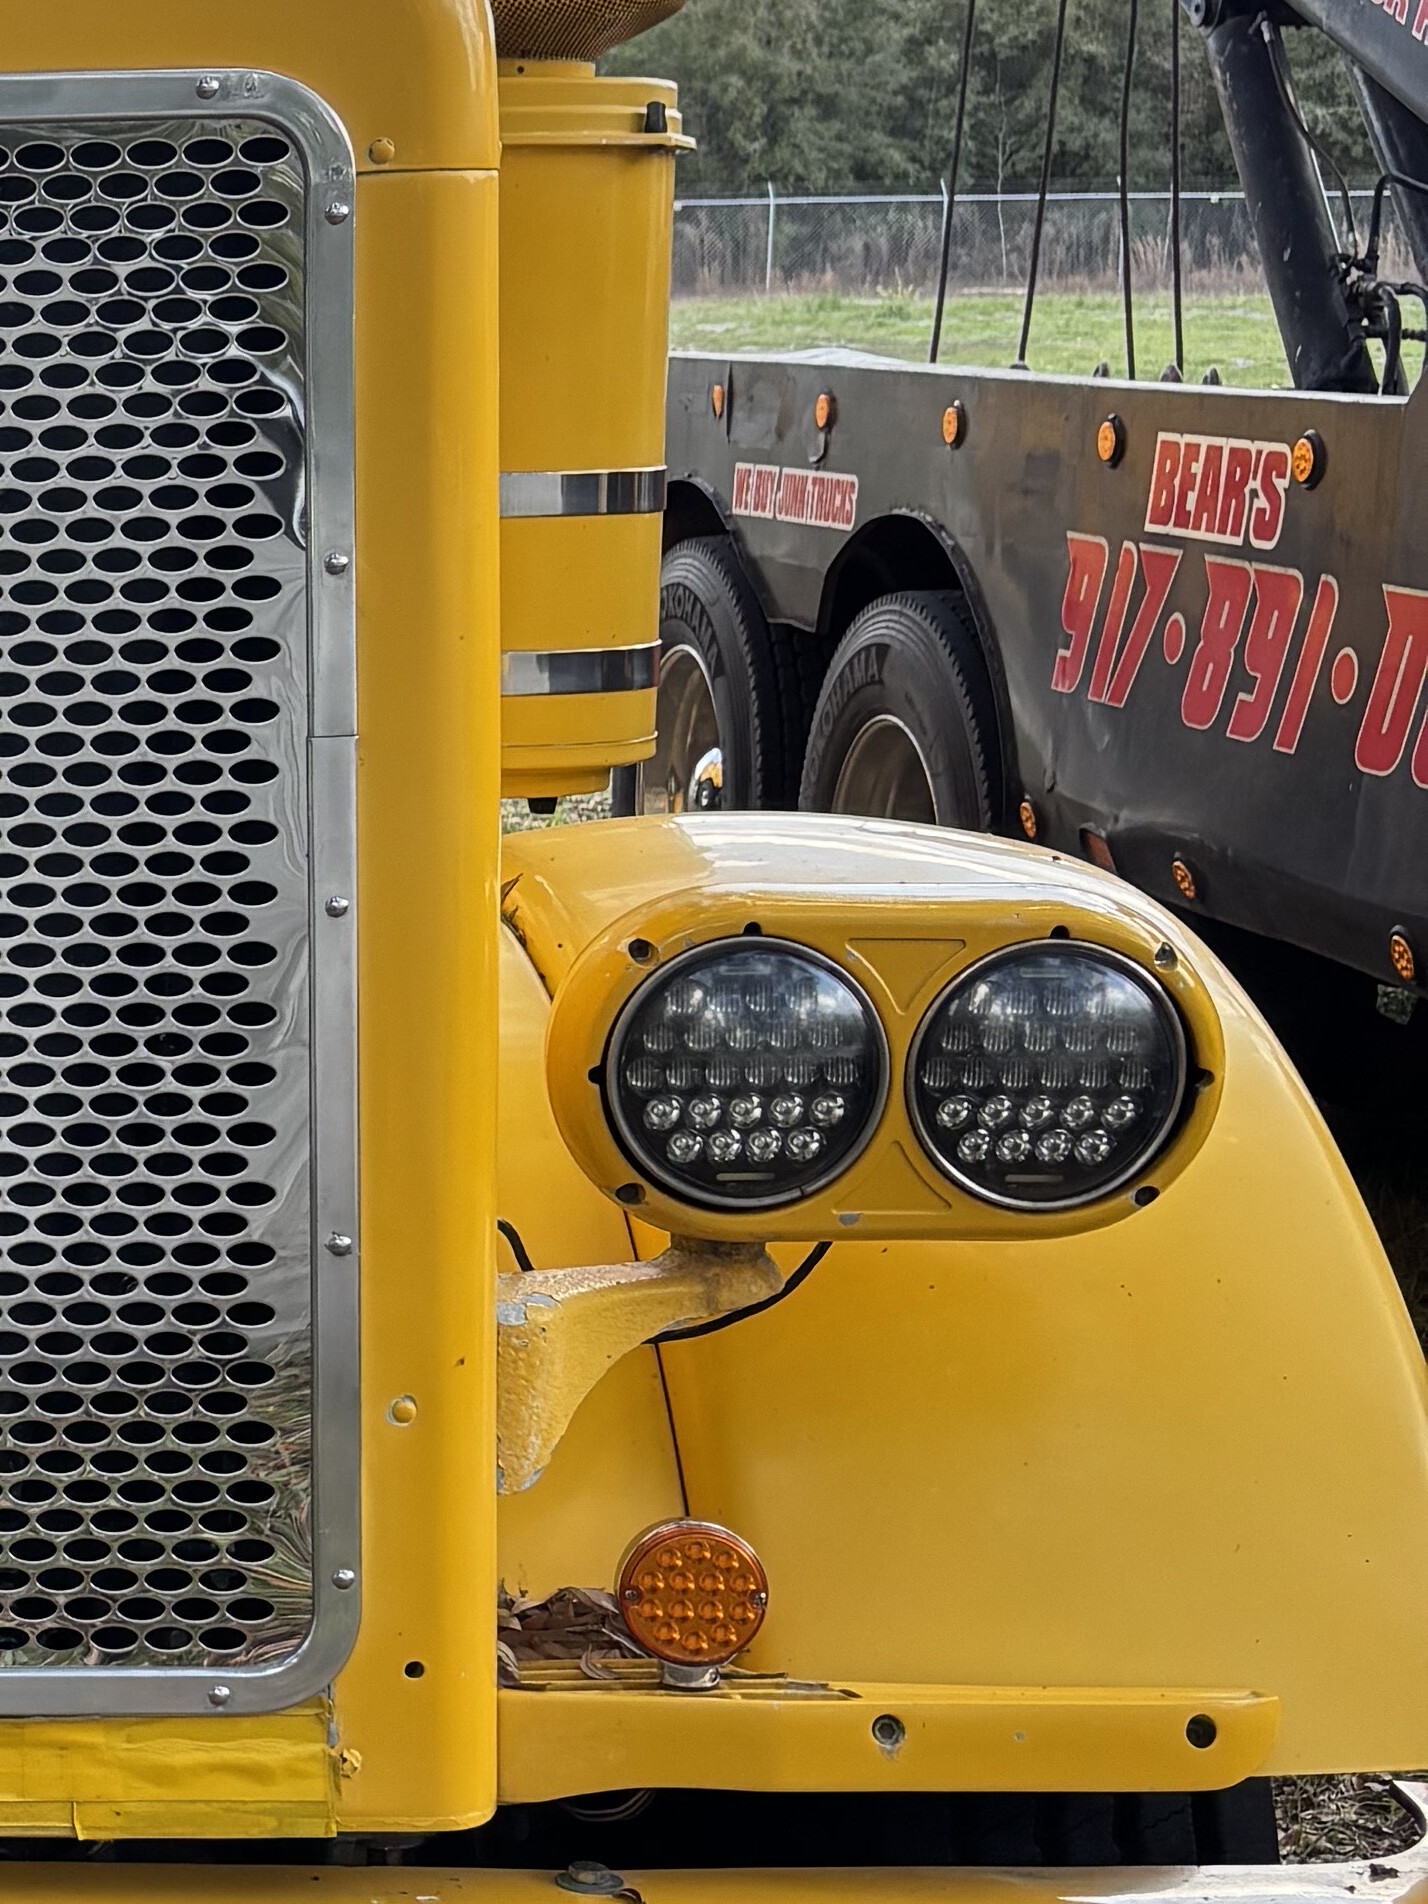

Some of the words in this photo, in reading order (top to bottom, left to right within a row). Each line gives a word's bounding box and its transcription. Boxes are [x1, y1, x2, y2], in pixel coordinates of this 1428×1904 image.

[752, 466, 778, 516] BUY
[808, 473, 857, 528] TRUCKS
[1145, 431, 1291, 550] BEAR'S
